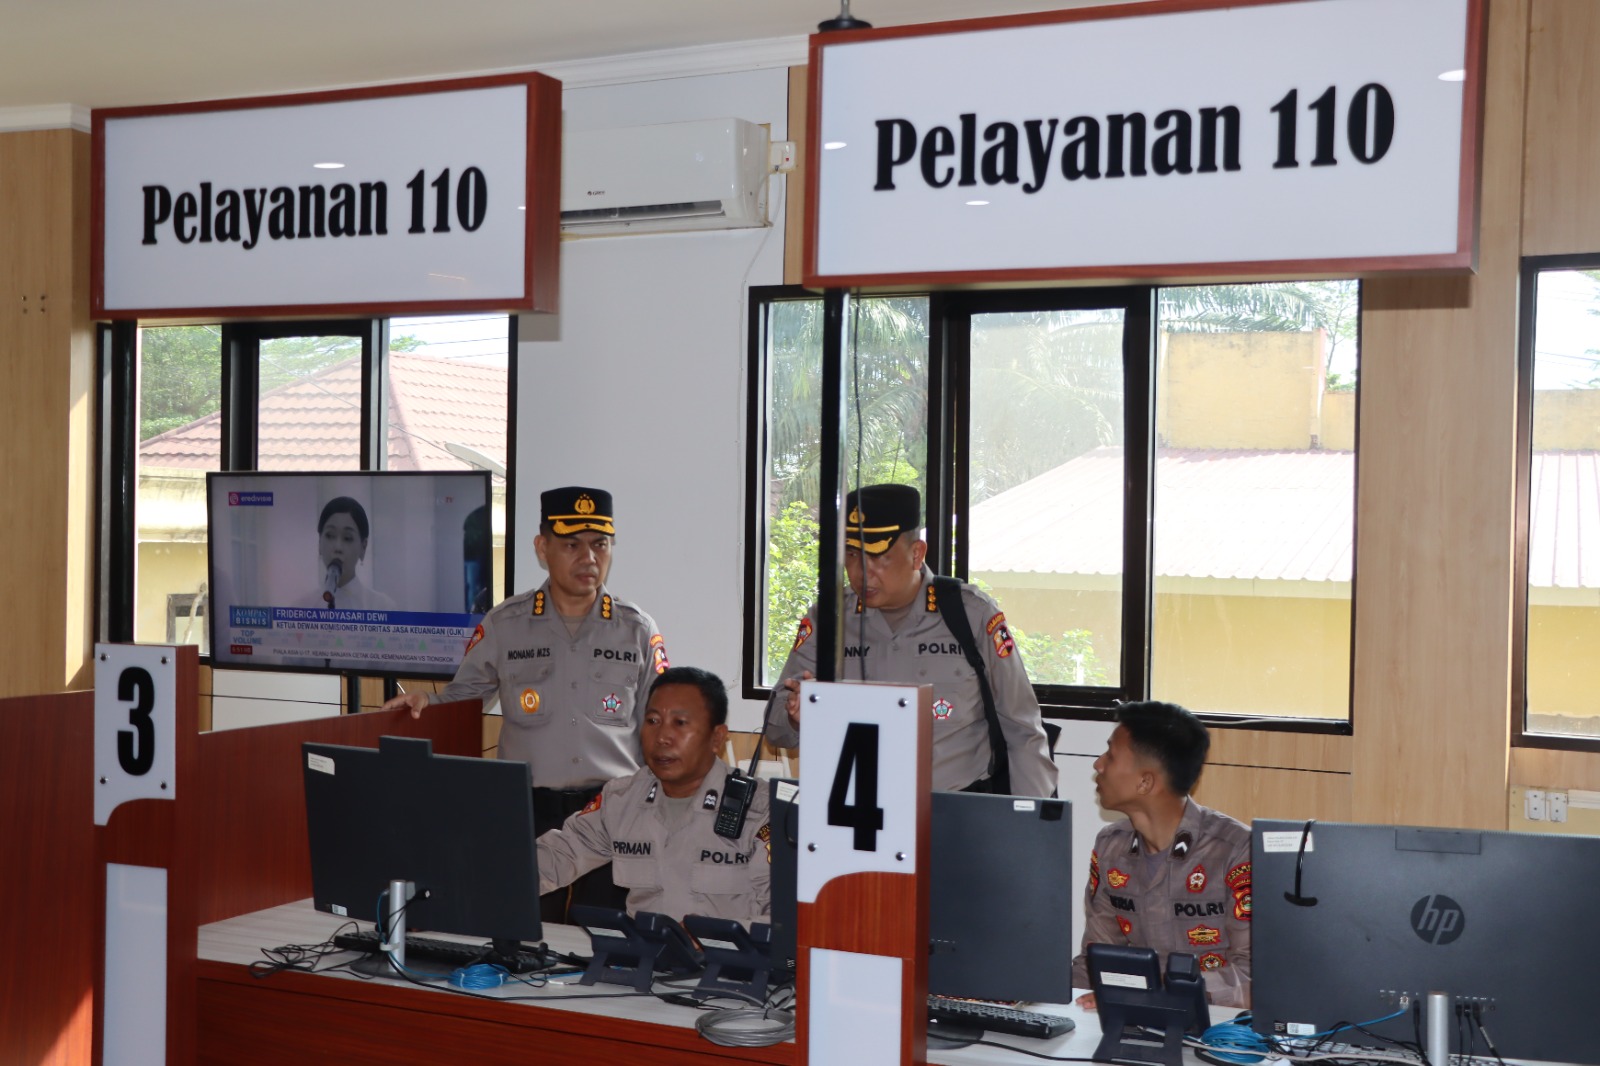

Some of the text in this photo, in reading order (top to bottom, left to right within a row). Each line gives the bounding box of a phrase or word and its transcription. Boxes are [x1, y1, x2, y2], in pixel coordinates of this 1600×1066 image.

[873, 82, 1395, 194] Pelayanan 110
[141, 166, 488, 250] Pelayanan 110
[235, 608, 268, 617] KOMPAS
[276, 608, 388, 622] FRIDERICA WIDYASARI DEWI
[235, 616, 267, 626] BISNIS
[240, 629, 255, 638] TOP
[276, 621, 465, 636] KETUA DEWAN KOMISIONER OTORITAS JASA KEUANGAN (OJK)
[233, 637, 262, 645] VOLUME
[507, 648, 535, 660] MONANG
[593, 648, 637, 663] POLRI
[918, 643, 962, 655] POLRI
[381, 653, 417, 661] KEMENANGAN
[117, 667, 155, 776] 3
[827, 722, 884, 852] 4
[1174, 902, 1225, 917] POLRI
[1415, 894, 1461, 945] hp
